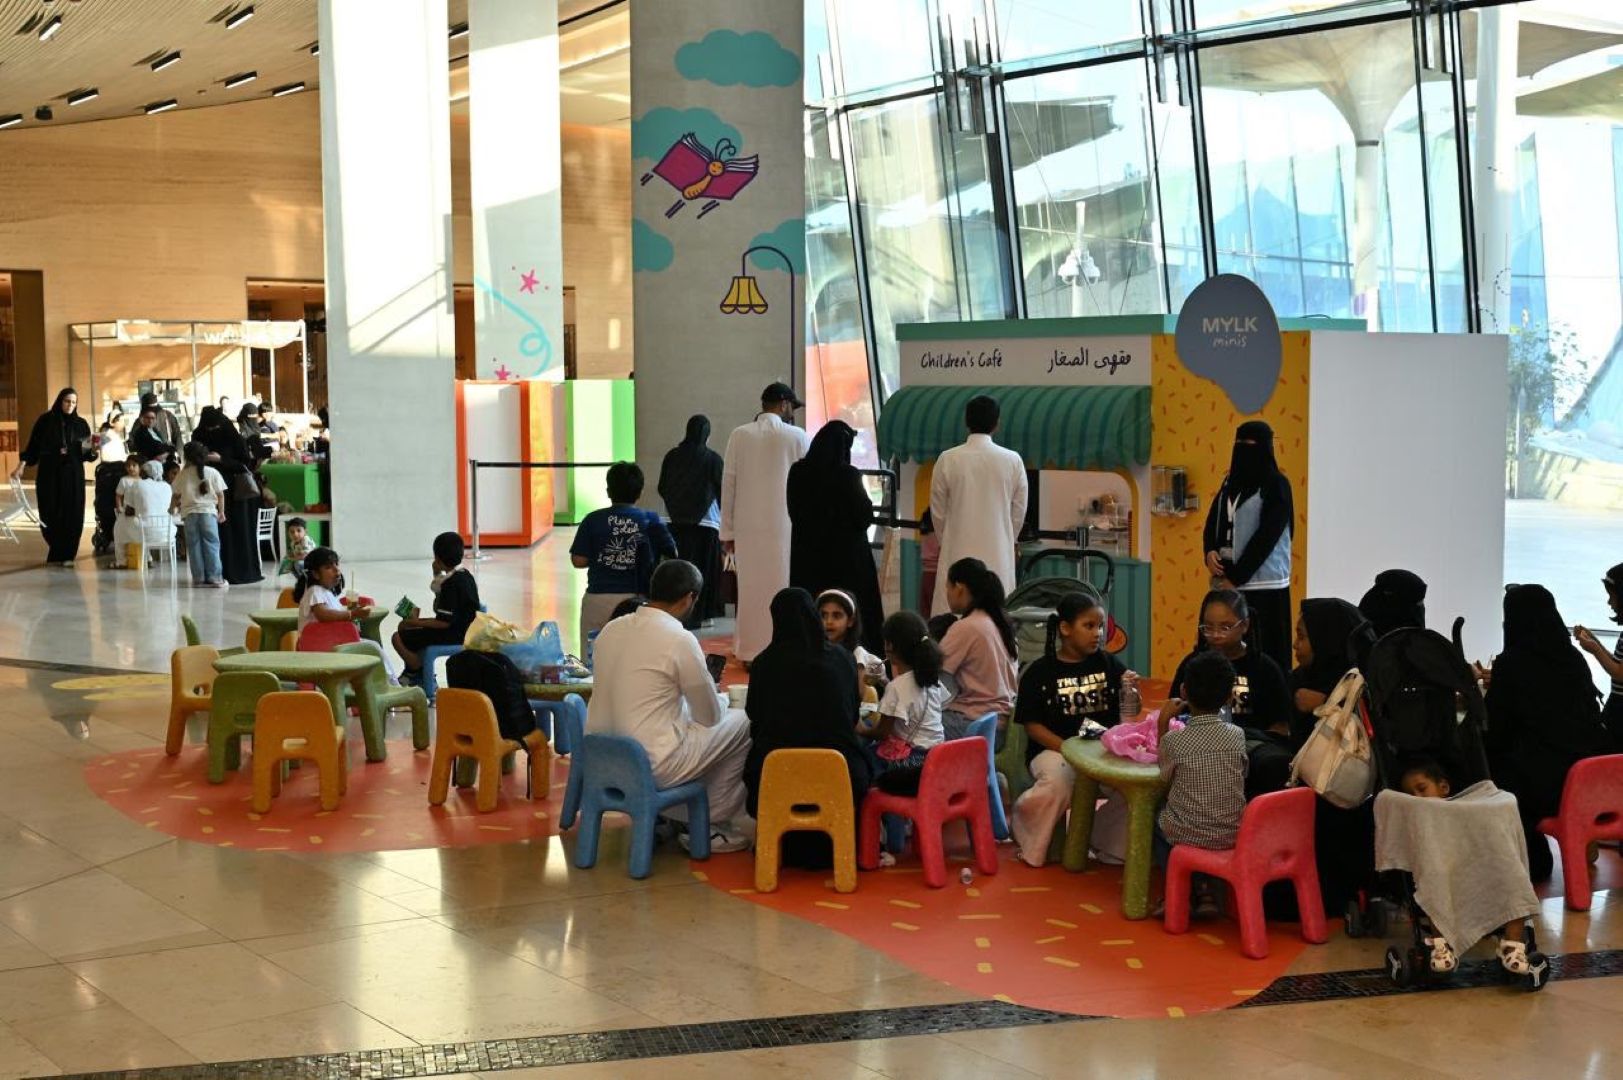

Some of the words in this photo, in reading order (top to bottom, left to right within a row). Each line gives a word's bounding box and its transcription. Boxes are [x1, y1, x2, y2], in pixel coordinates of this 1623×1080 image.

[1202, 316, 1258, 333] MYLK
[1213, 333, 1247, 348] minis
[921, 351, 974, 369] Children's
[978, 348, 1003, 367] Café
[1047, 346, 1089, 373] الصغار
